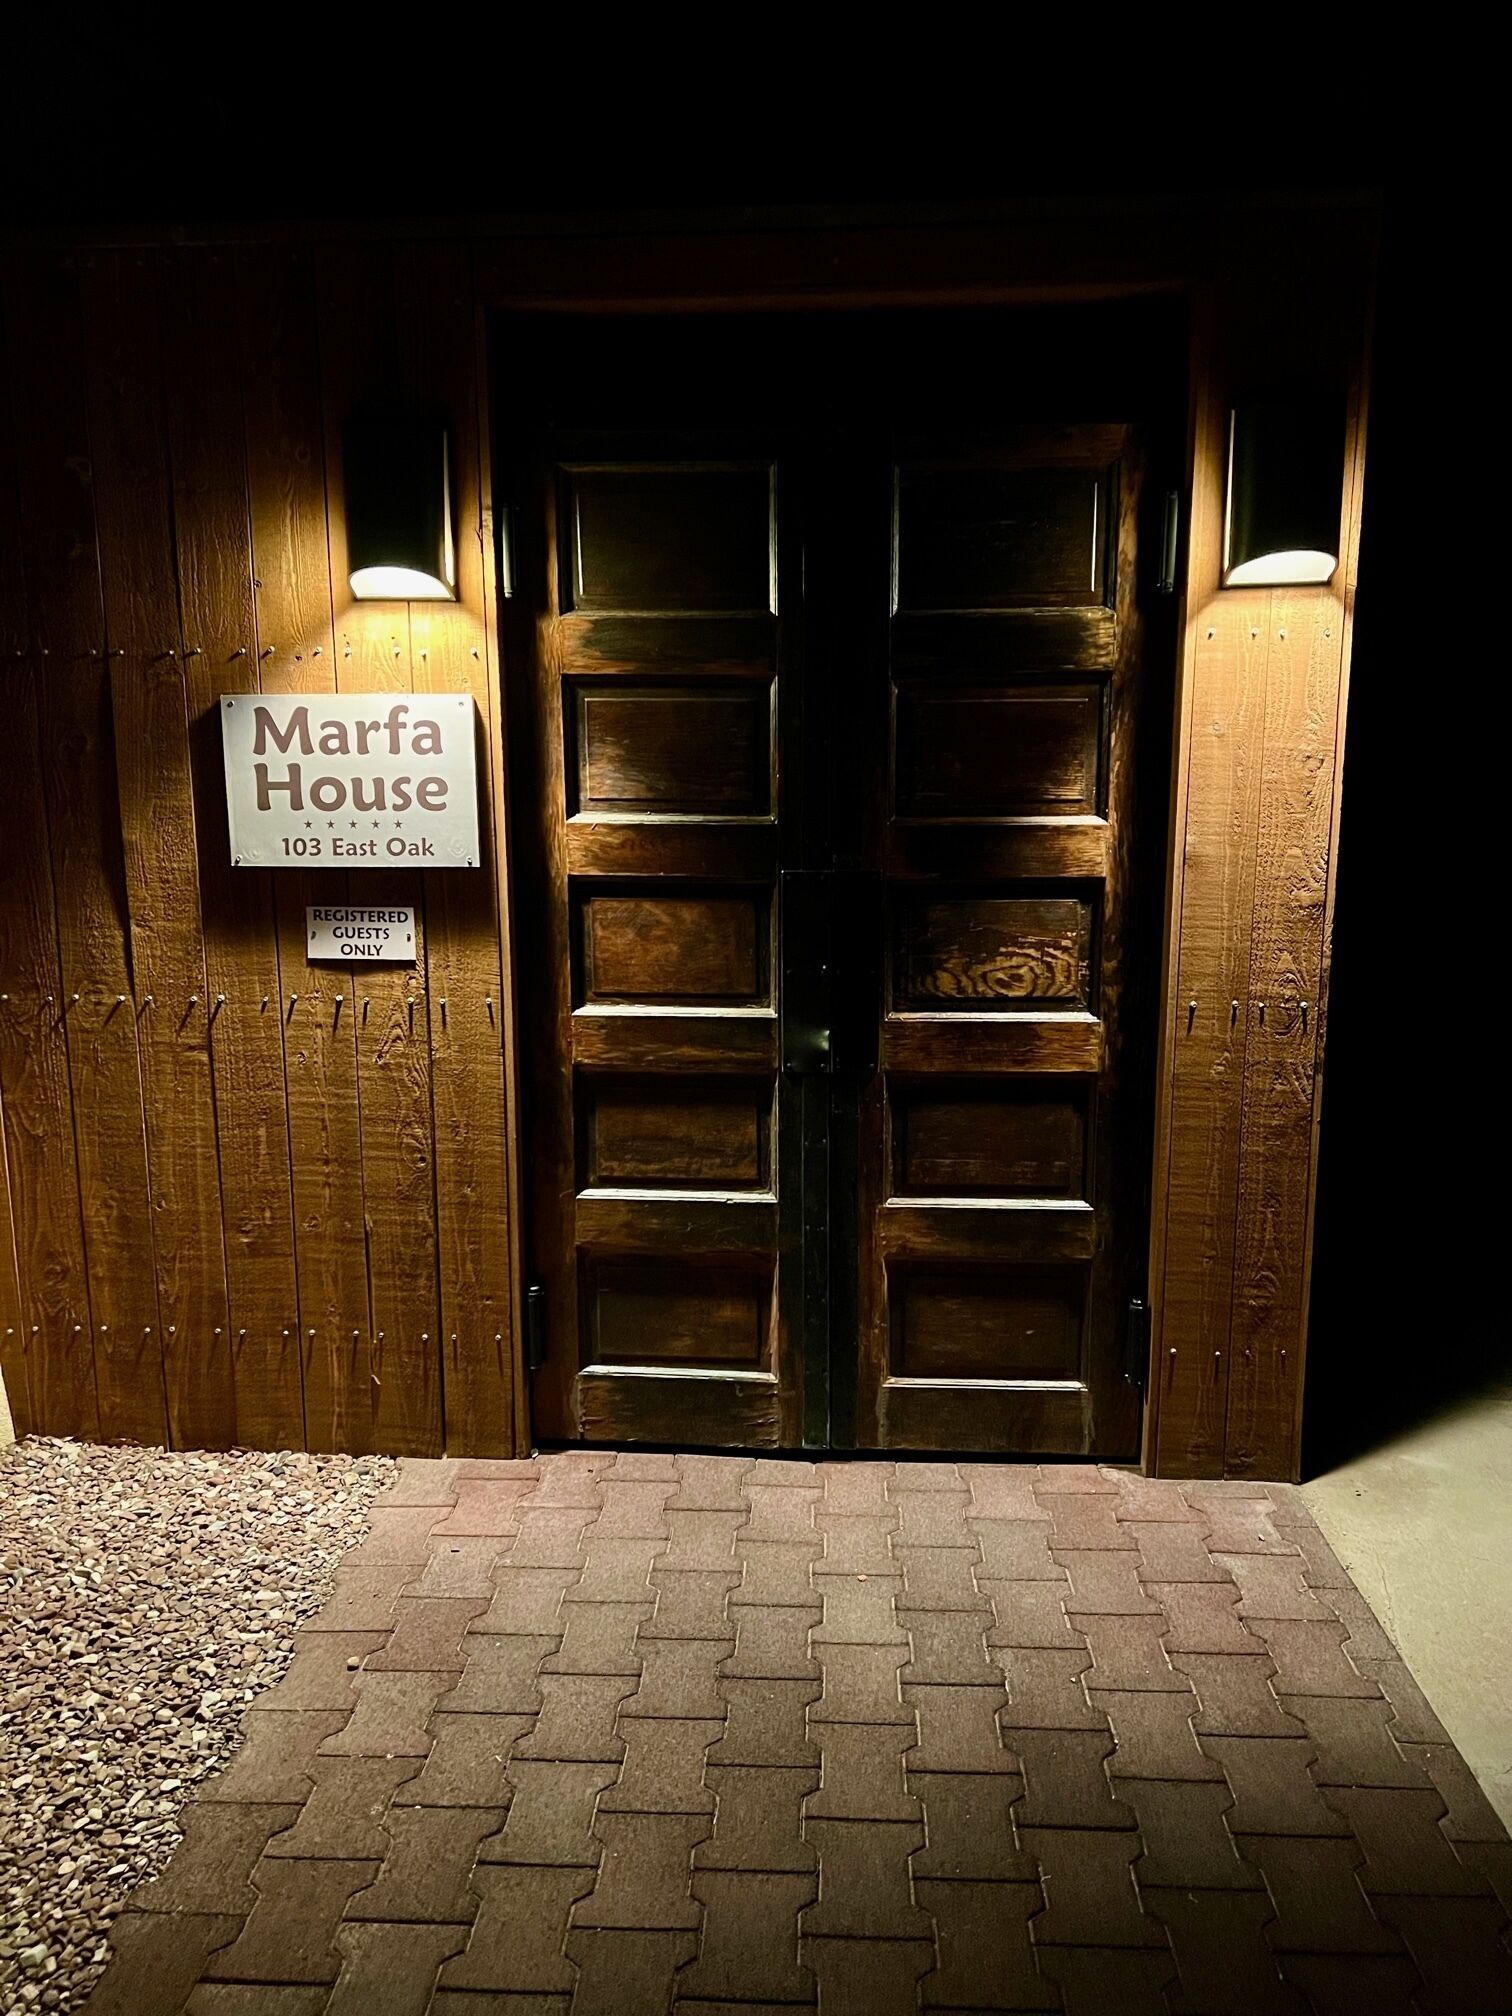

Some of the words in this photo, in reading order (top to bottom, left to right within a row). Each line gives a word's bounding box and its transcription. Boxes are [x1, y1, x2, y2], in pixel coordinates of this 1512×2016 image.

[252, 704, 444, 756] Marfa
[253, 762, 449, 812] House
[281, 837, 322, 856] 103
[331, 837, 377, 856] East
[386, 837, 435, 856] Oak
[312, 909, 409, 923] REGISTERED
[332, 927, 390, 939] GUESTS
[340, 944, 383, 956] ONLY
